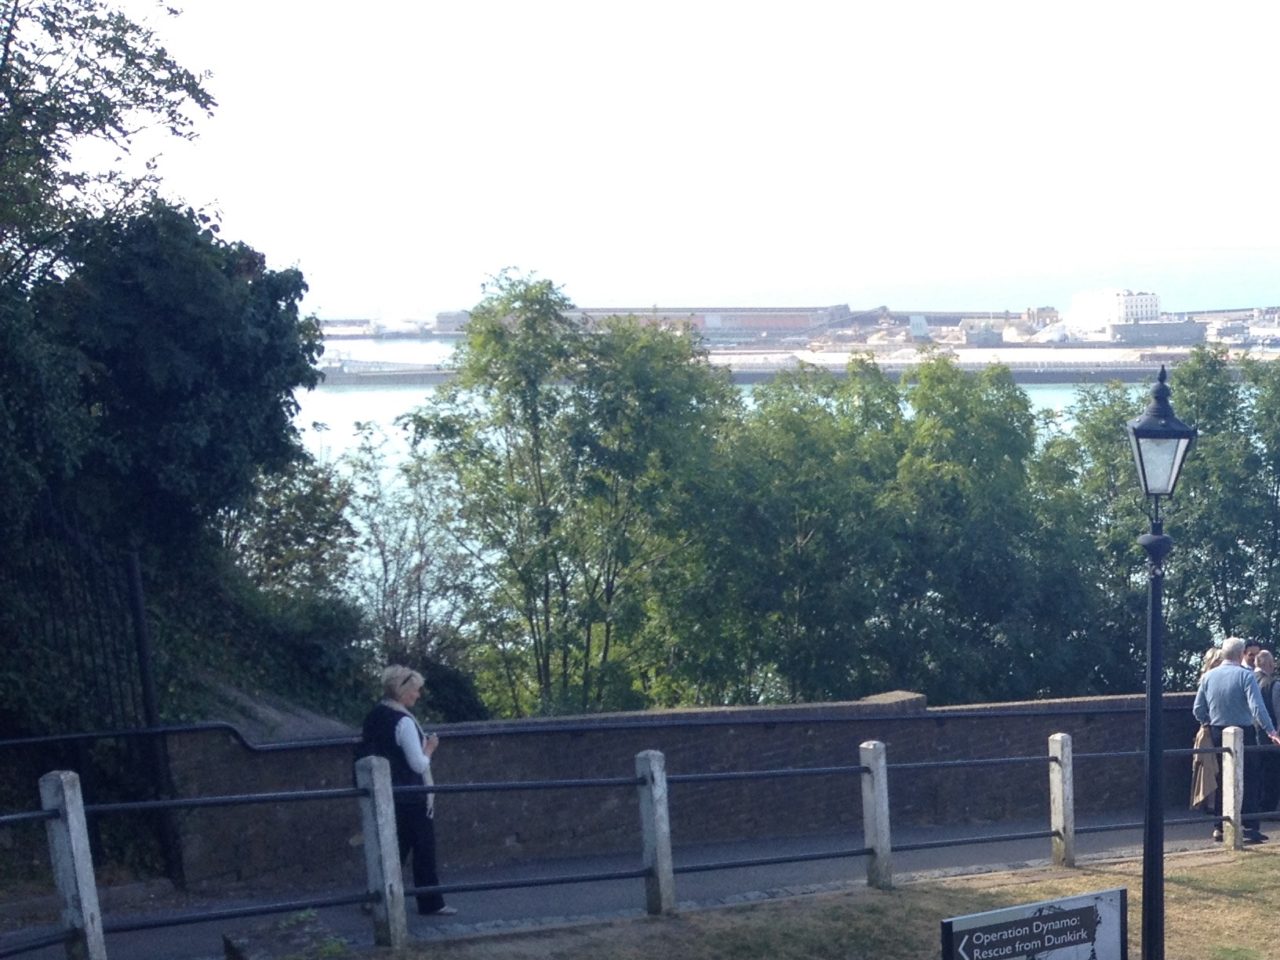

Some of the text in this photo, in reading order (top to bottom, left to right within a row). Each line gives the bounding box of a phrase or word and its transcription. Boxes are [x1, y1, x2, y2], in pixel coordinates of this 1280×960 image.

[972, 916, 1081, 945] Operation Dynamo:
[973, 929, 1088, 960] Rescue from Dunkirk
